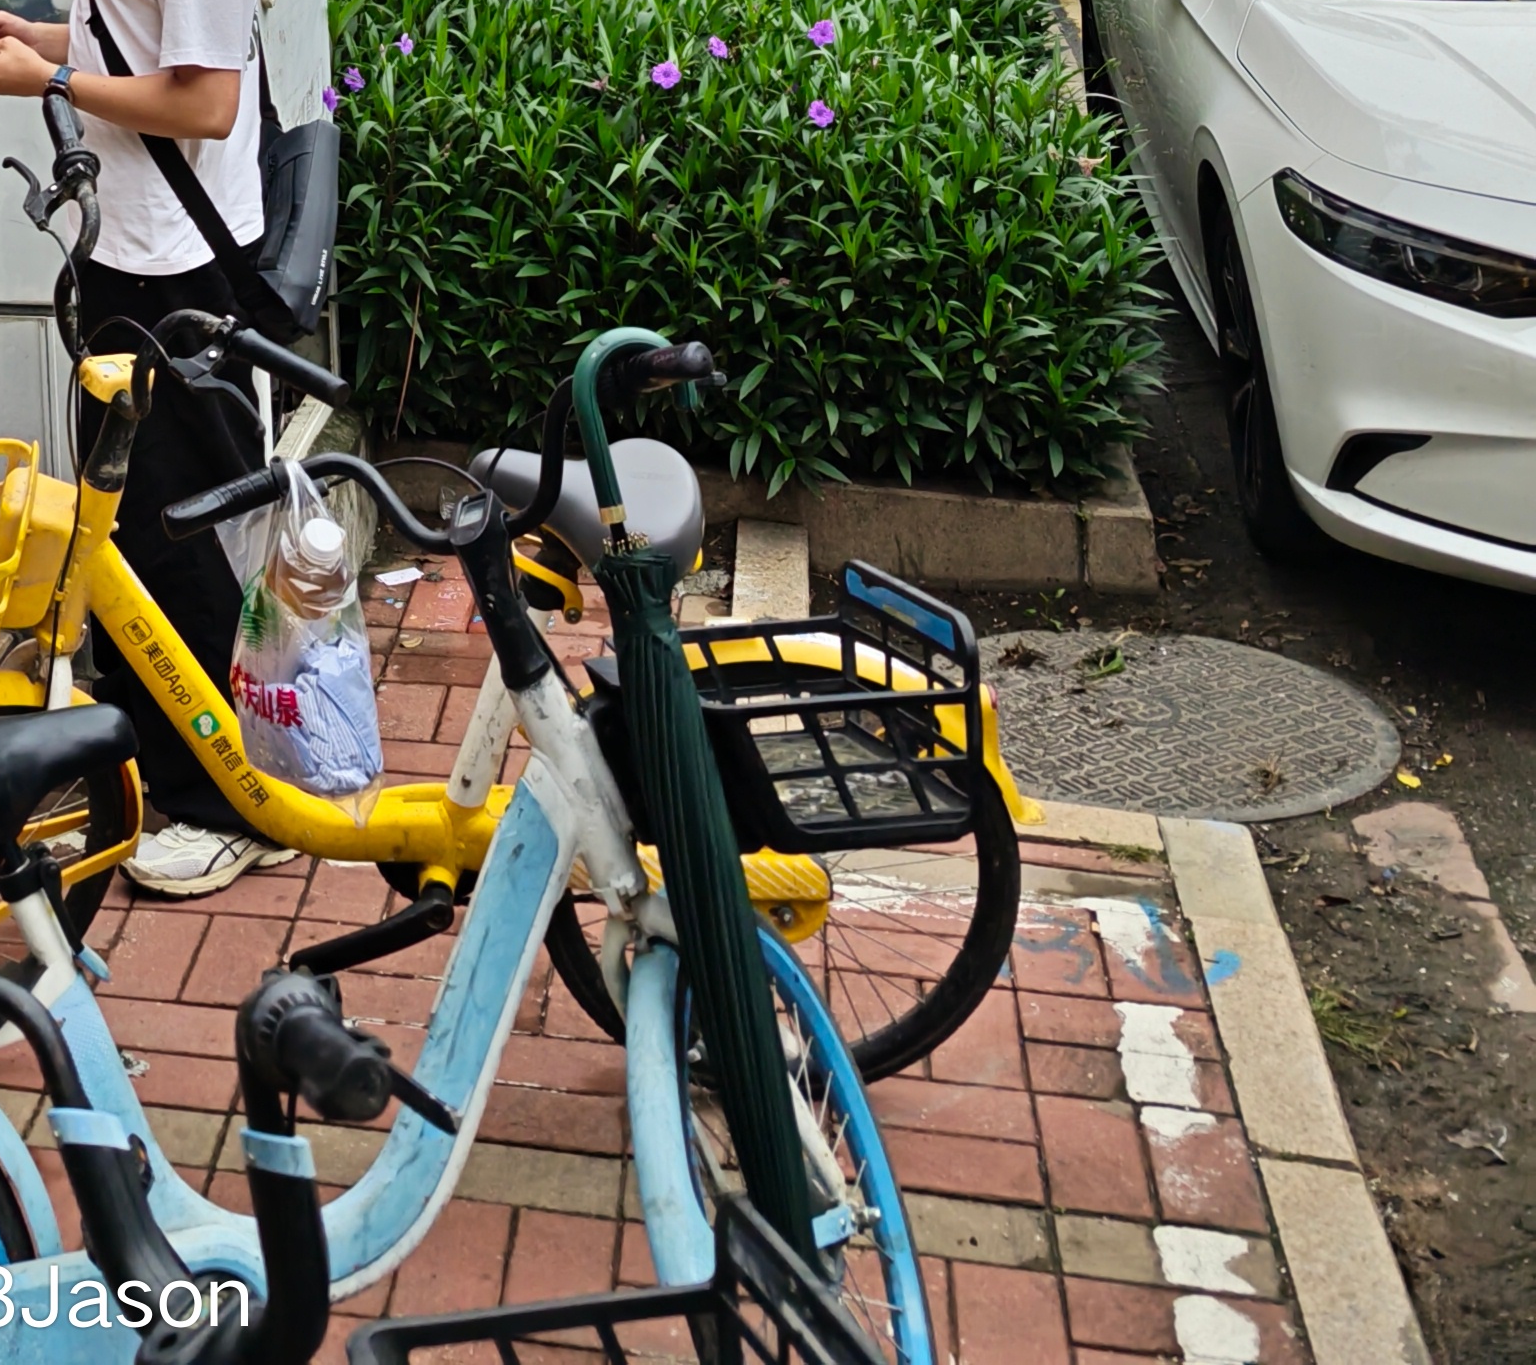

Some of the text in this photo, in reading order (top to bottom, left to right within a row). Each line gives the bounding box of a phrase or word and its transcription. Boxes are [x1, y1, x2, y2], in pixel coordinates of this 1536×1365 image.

[141, 641, 270, 808] 美团App 微信 扫码
